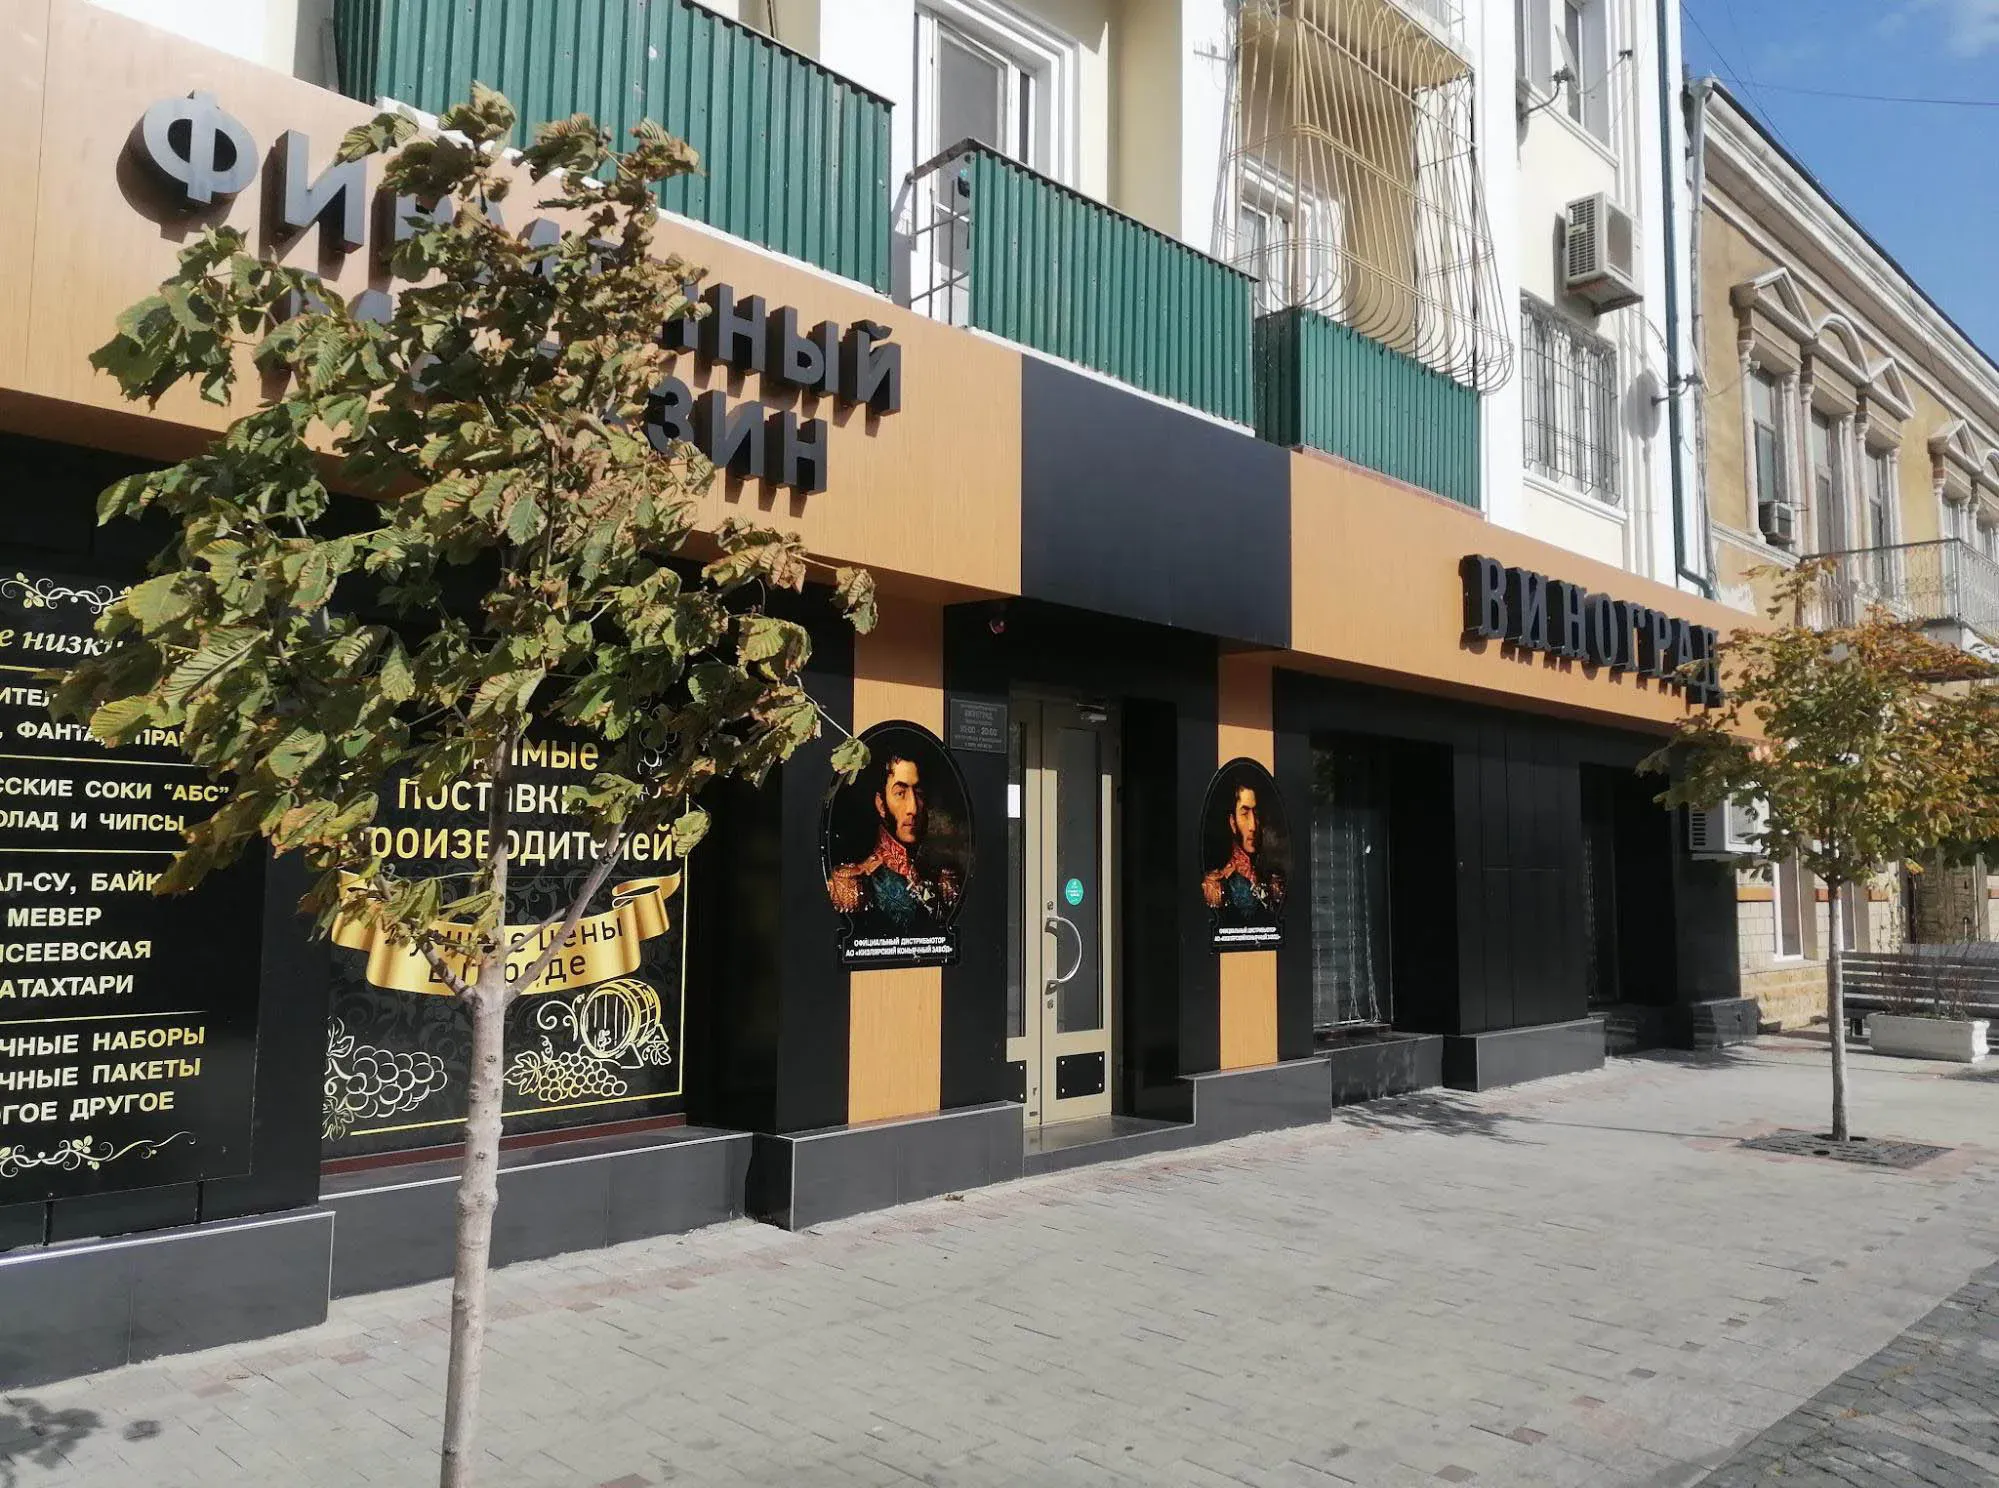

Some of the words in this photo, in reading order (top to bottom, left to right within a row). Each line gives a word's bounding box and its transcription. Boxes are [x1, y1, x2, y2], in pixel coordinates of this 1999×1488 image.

[1460, 554, 1723, 707] ВИНОГРАД
[0, 777, 73, 796] СКИЕ
[85, 781, 151, 799] СОКИ
[164, 784, 229, 801] “АБС”
[70, 812, 87, 829] И
[100, 813, 184, 832] ЧИПСЫ
[91, 870, 194, 892] БАЙК
[8, 907, 102, 927] МЕВЕР
[0, 940, 152, 963] СЕЕВСКАЯ
[0, 975, 134, 999] АТАХТАРИ
[0, 1034, 79, 1057] ЧНЫЕ
[93, 1027, 205, 1051] НАБОРЫ
[0, 1067, 79, 1091] ЧНЫЕ
[93, 1058, 201, 1084] ПАКЕТЫ
[0, 1101, 58, 1125] ГОЕ
[69, 1091, 175, 1121] ДРУГОЕ
